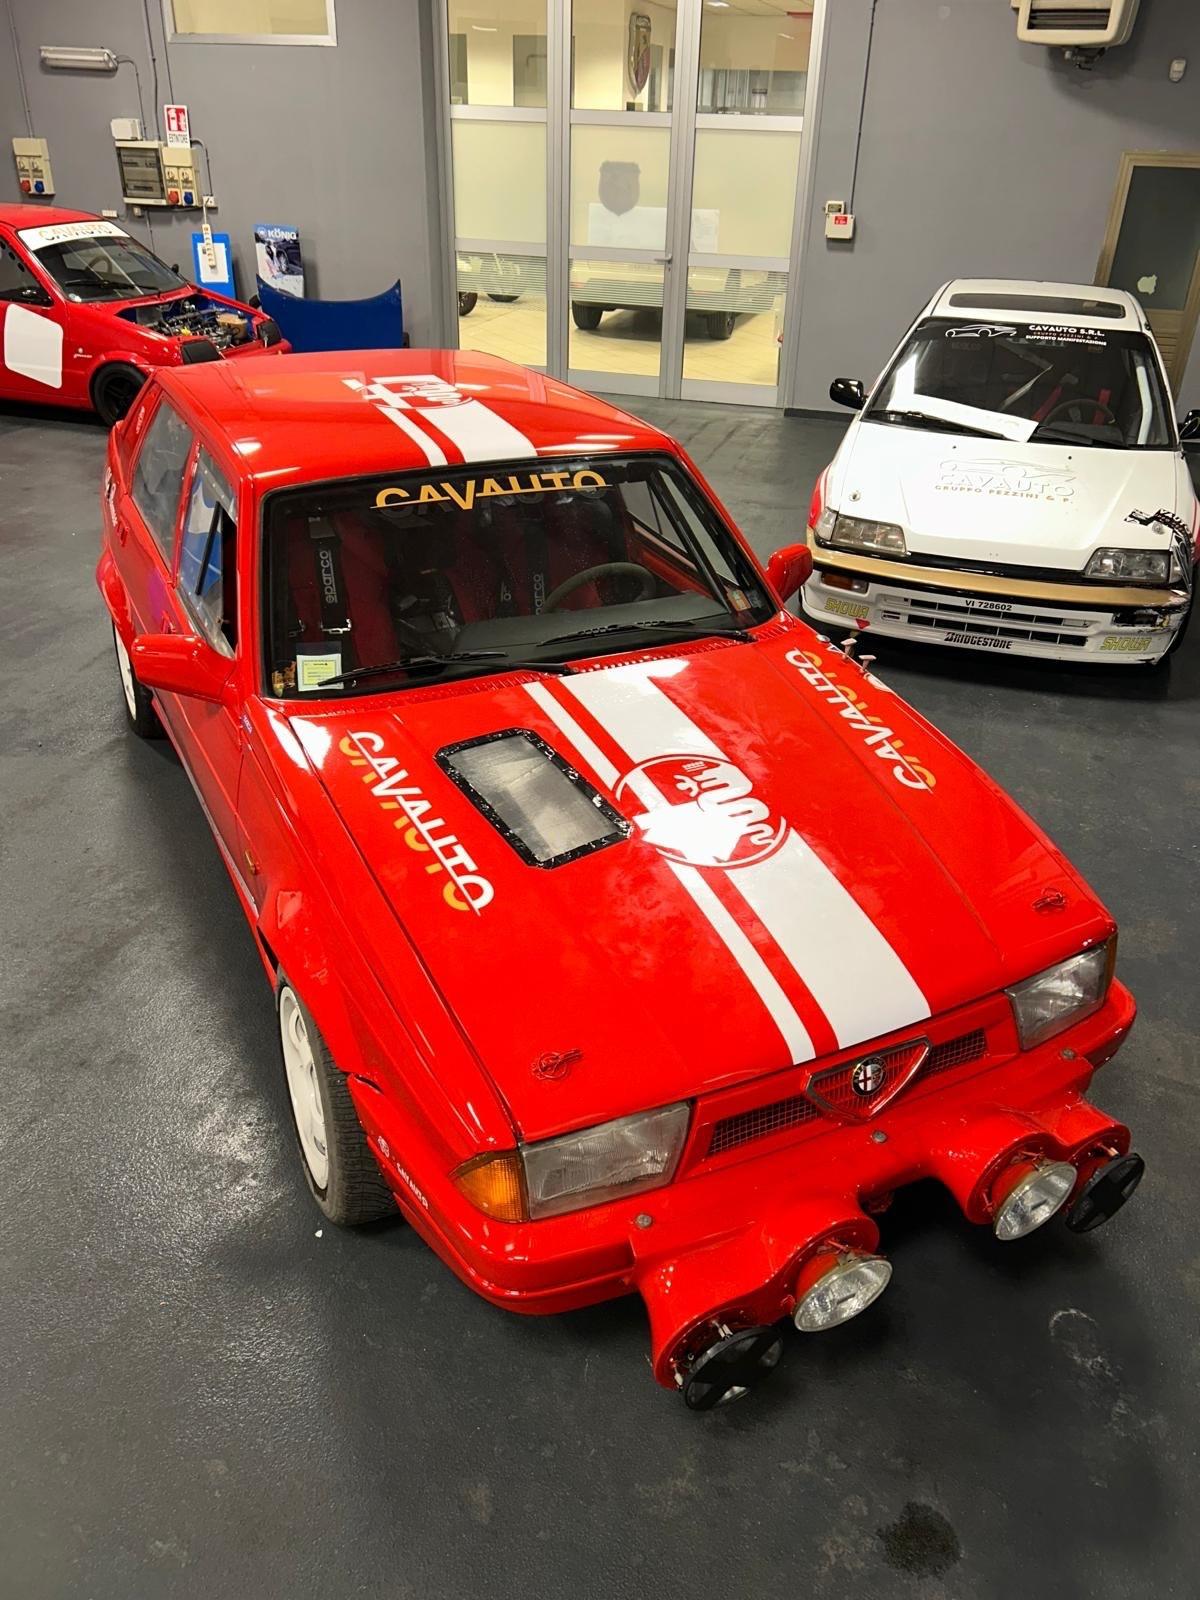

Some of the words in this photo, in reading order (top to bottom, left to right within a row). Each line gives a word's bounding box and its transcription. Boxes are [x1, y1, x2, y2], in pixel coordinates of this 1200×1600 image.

[267, 228, 298, 241] KÖNIG
[1028, 325, 1077, 334] CAVAUTO
[1079, 328, 1105, 337] S.R.L.
[1057, 337, 1107, 346] MANIFESTAZIONE
[370, 470, 613, 512] CAVAUTO
[934, 485, 983, 493] GRUPPO
[988, 489, 1039, 499] PEZZINI
[940, 473, 1075, 497] CAVAUTO
[965, 599, 975, 607] VI
[978, 601, 1013, 611] 728602
[944, 631, 1013, 649] BRIDGESTONE
[785, 647, 937, 793] CAVAUTO
[338, 730, 495, 916] CAVAUTO
